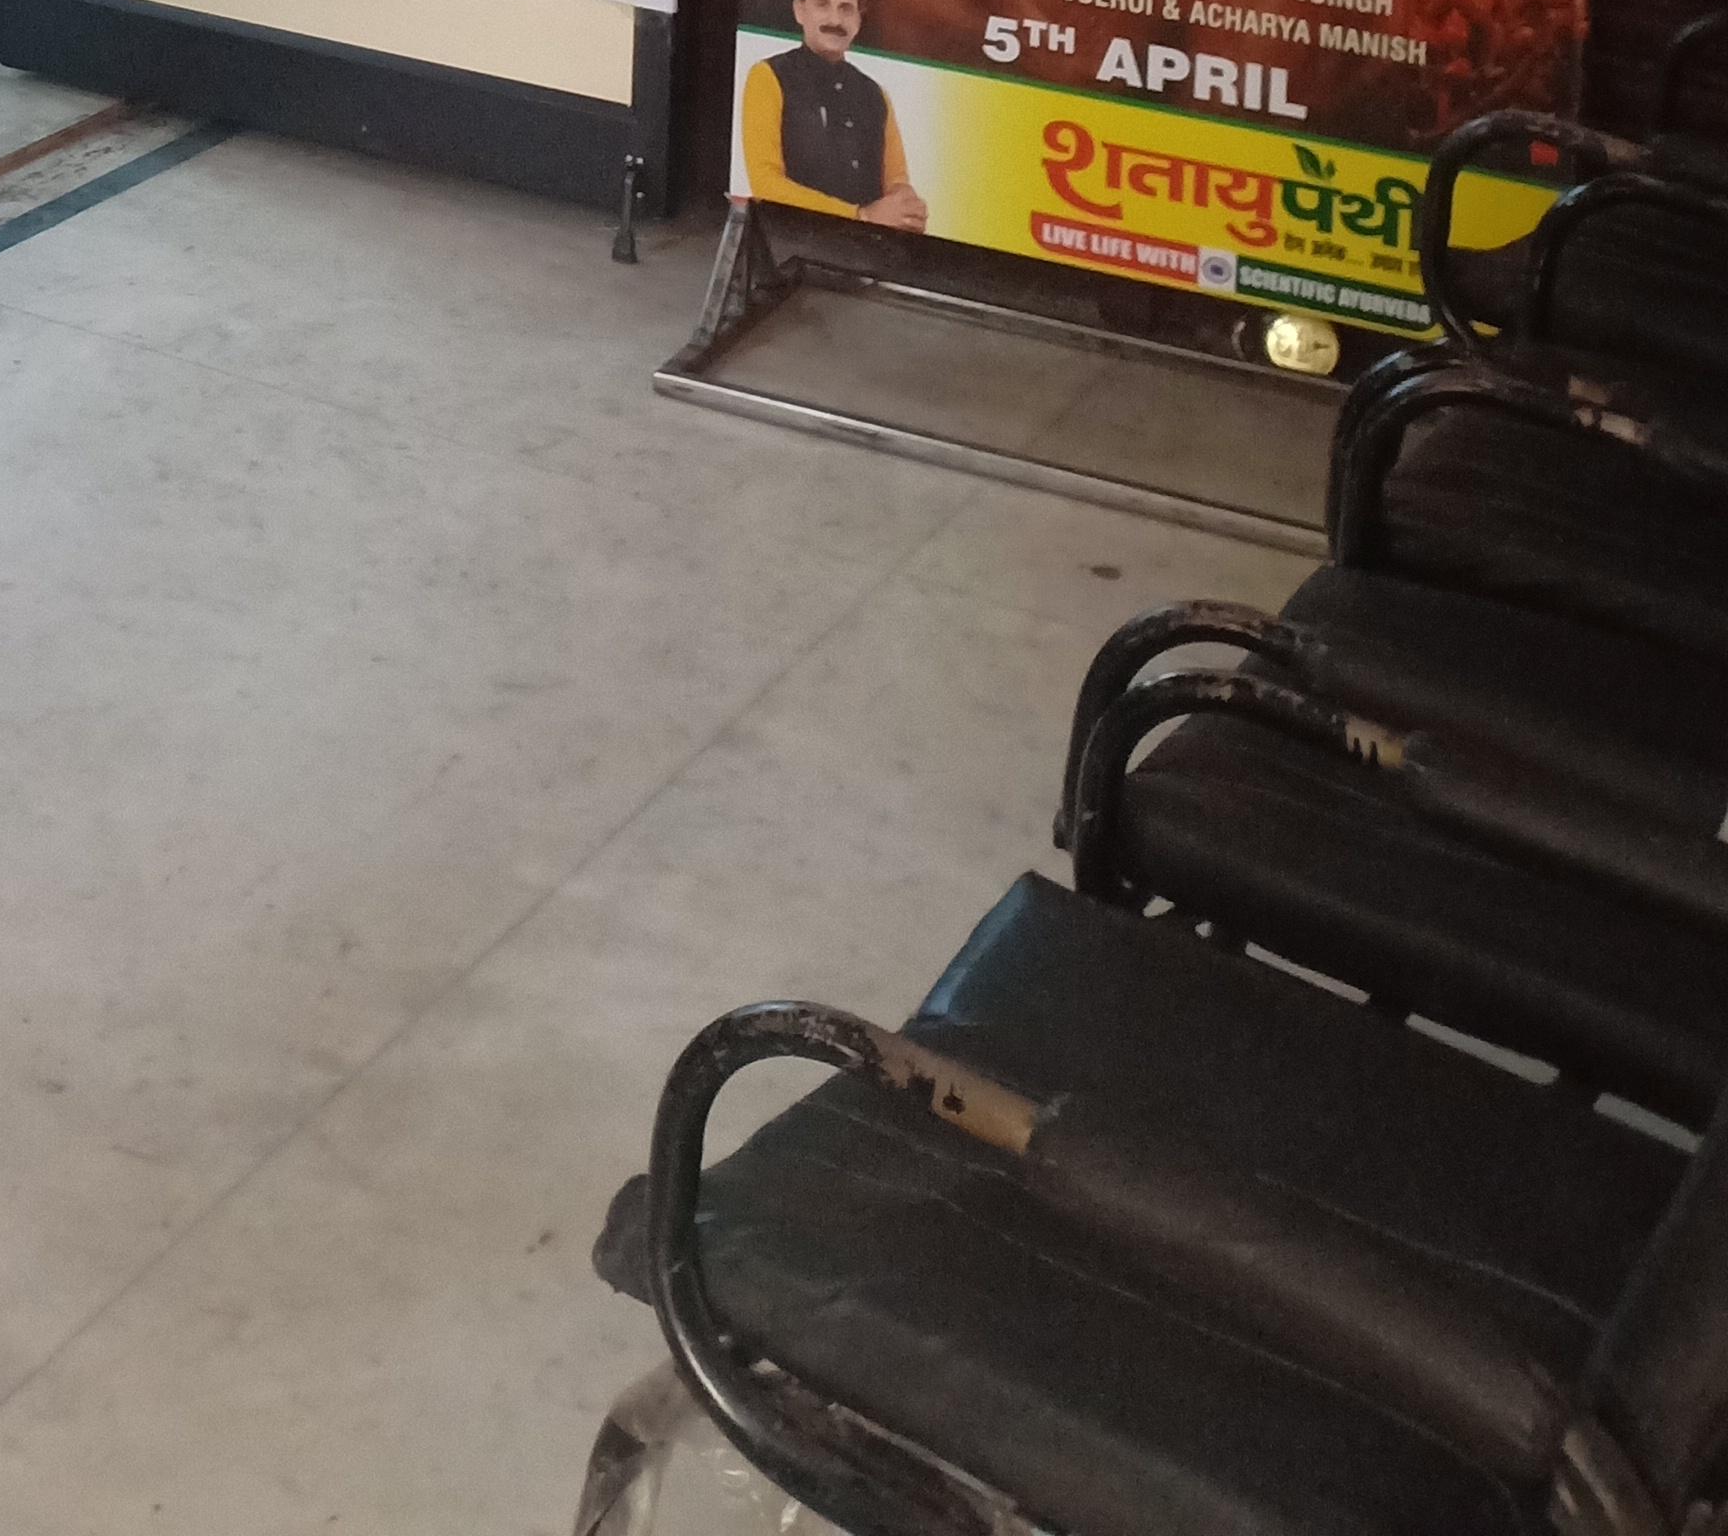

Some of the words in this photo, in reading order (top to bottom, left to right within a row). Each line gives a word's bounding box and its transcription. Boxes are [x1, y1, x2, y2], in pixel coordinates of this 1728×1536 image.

[1190, 0, 1311, 44] ACHARYA
[1319, 26, 1427, 65] MANISH
[983, 16, 1076, 65] 5TH
[1097, 37, 1309, 120] APRIL
[1042, 223, 1087, 245] LIVE
[1091, 231, 1132, 260] LIFE
[1137, 242, 1196, 274] WITH
